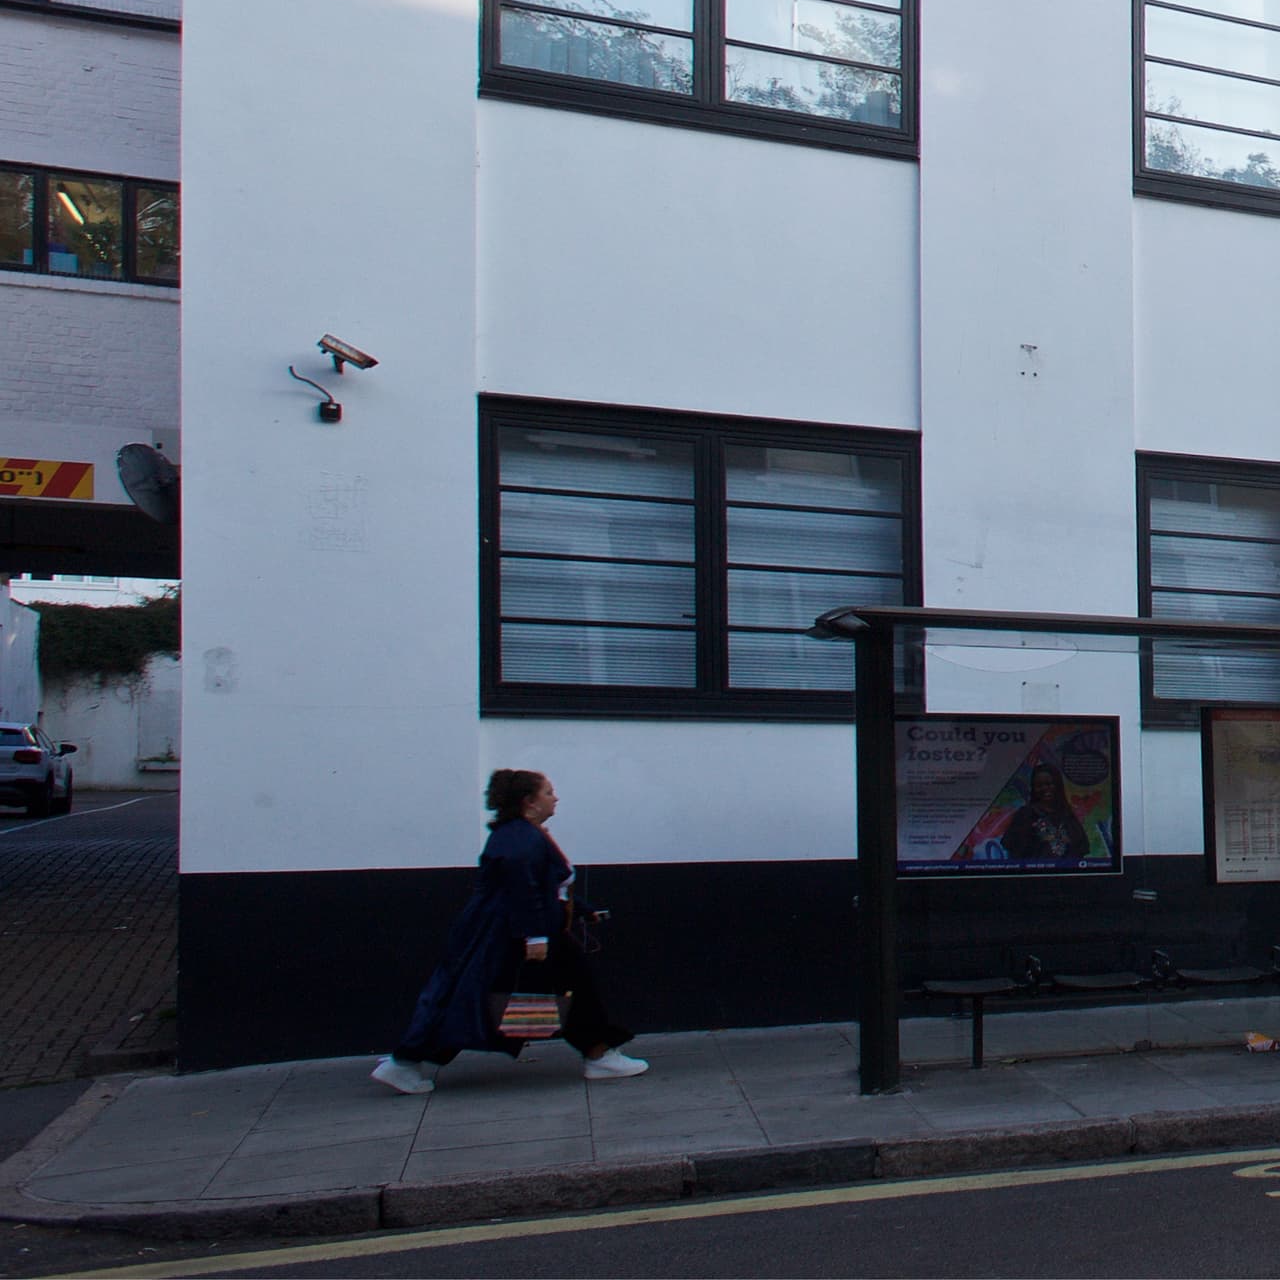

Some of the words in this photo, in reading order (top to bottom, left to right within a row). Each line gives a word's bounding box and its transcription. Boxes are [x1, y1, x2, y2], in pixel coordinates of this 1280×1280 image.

[907, 725, 976, 742] Could
[983, 730, 1025, 746] you
[907, 745, 987, 761] foster?
